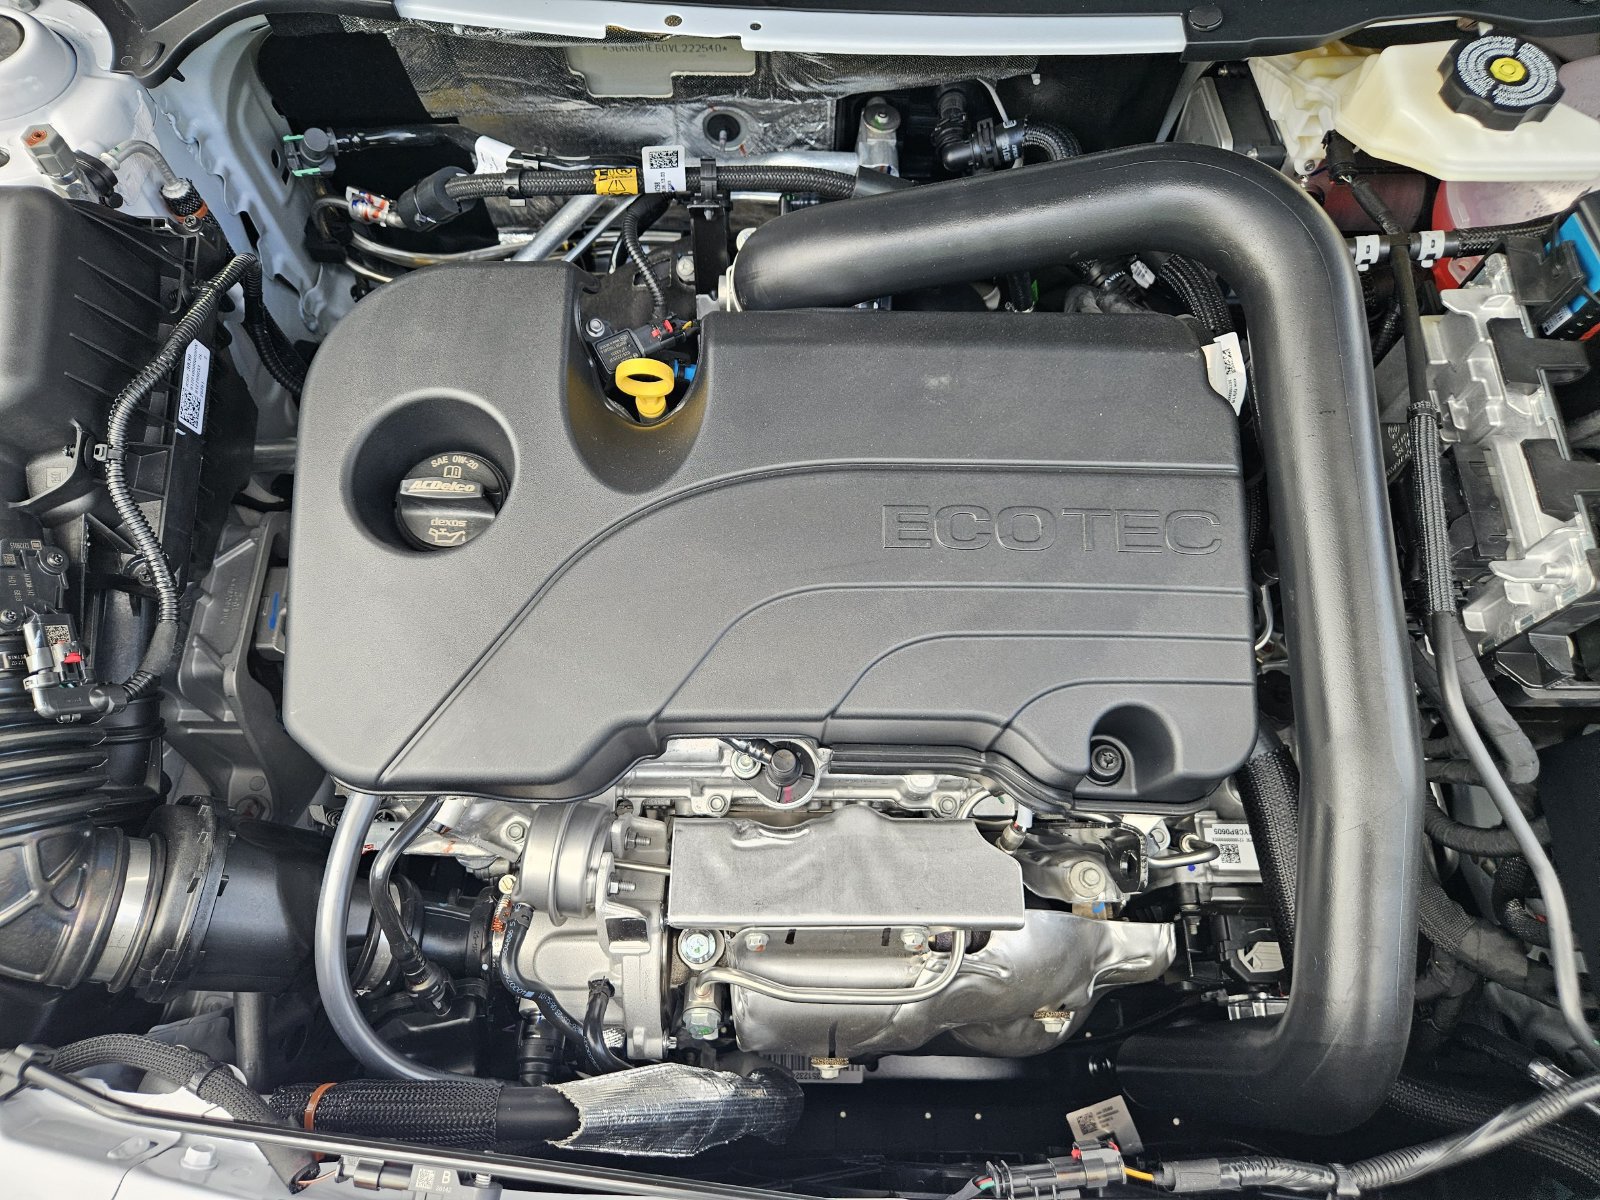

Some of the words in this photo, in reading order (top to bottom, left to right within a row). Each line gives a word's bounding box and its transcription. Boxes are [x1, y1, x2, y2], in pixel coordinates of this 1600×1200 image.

[431, 456, 449, 468] SAE
[452, 455, 479, 470] 0W-20
[408, 479, 476, 493] ACDelco
[430, 517, 468, 527] dexos
[882, 504, 1222, 556] ECOTEC
[441, 1169, 451, 1184] B
